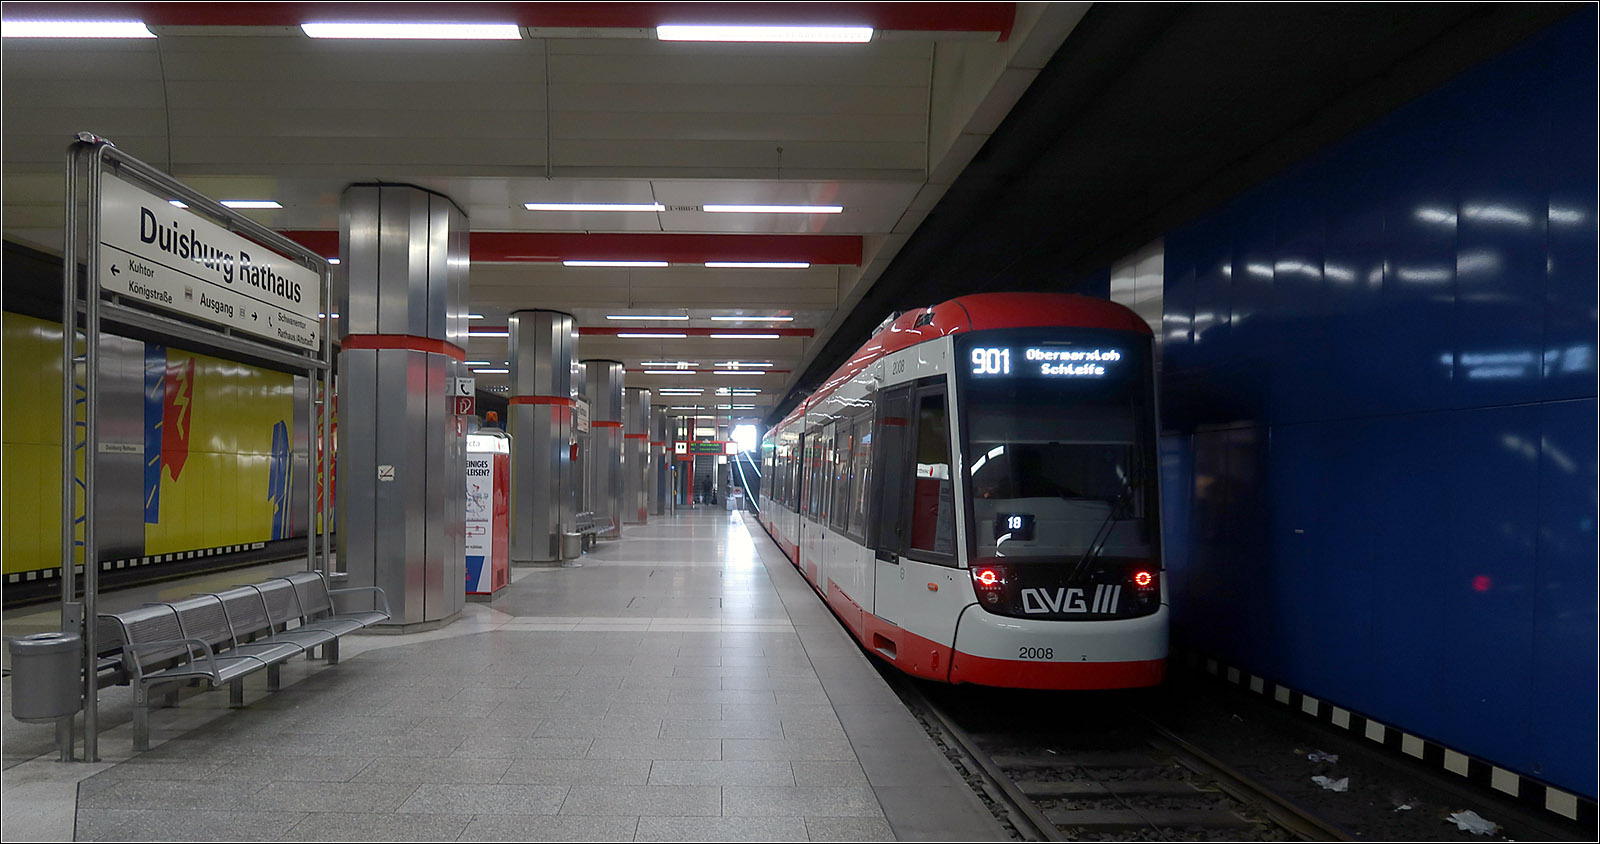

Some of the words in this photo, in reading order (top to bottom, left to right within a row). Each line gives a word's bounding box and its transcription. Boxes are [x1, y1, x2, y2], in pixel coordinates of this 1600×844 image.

[140, 206, 234, 284] Duisburg
[239, 250, 302, 304] Rathaus
[129, 259, 155, 278] Kuhtor
[128, 280, 173, 304] Königstraße
[200, 293, 234, 318] Ausgang
[892, 359, 905, 376] 2008
[971, 348, 1010, 375] 901
[1040, 363, 1105, 376] Schleife
[466, 469, 490, 477] LEISEN?
[1007, 516, 1022, 530] 18
[1018, 647, 1054, 660] 2008
